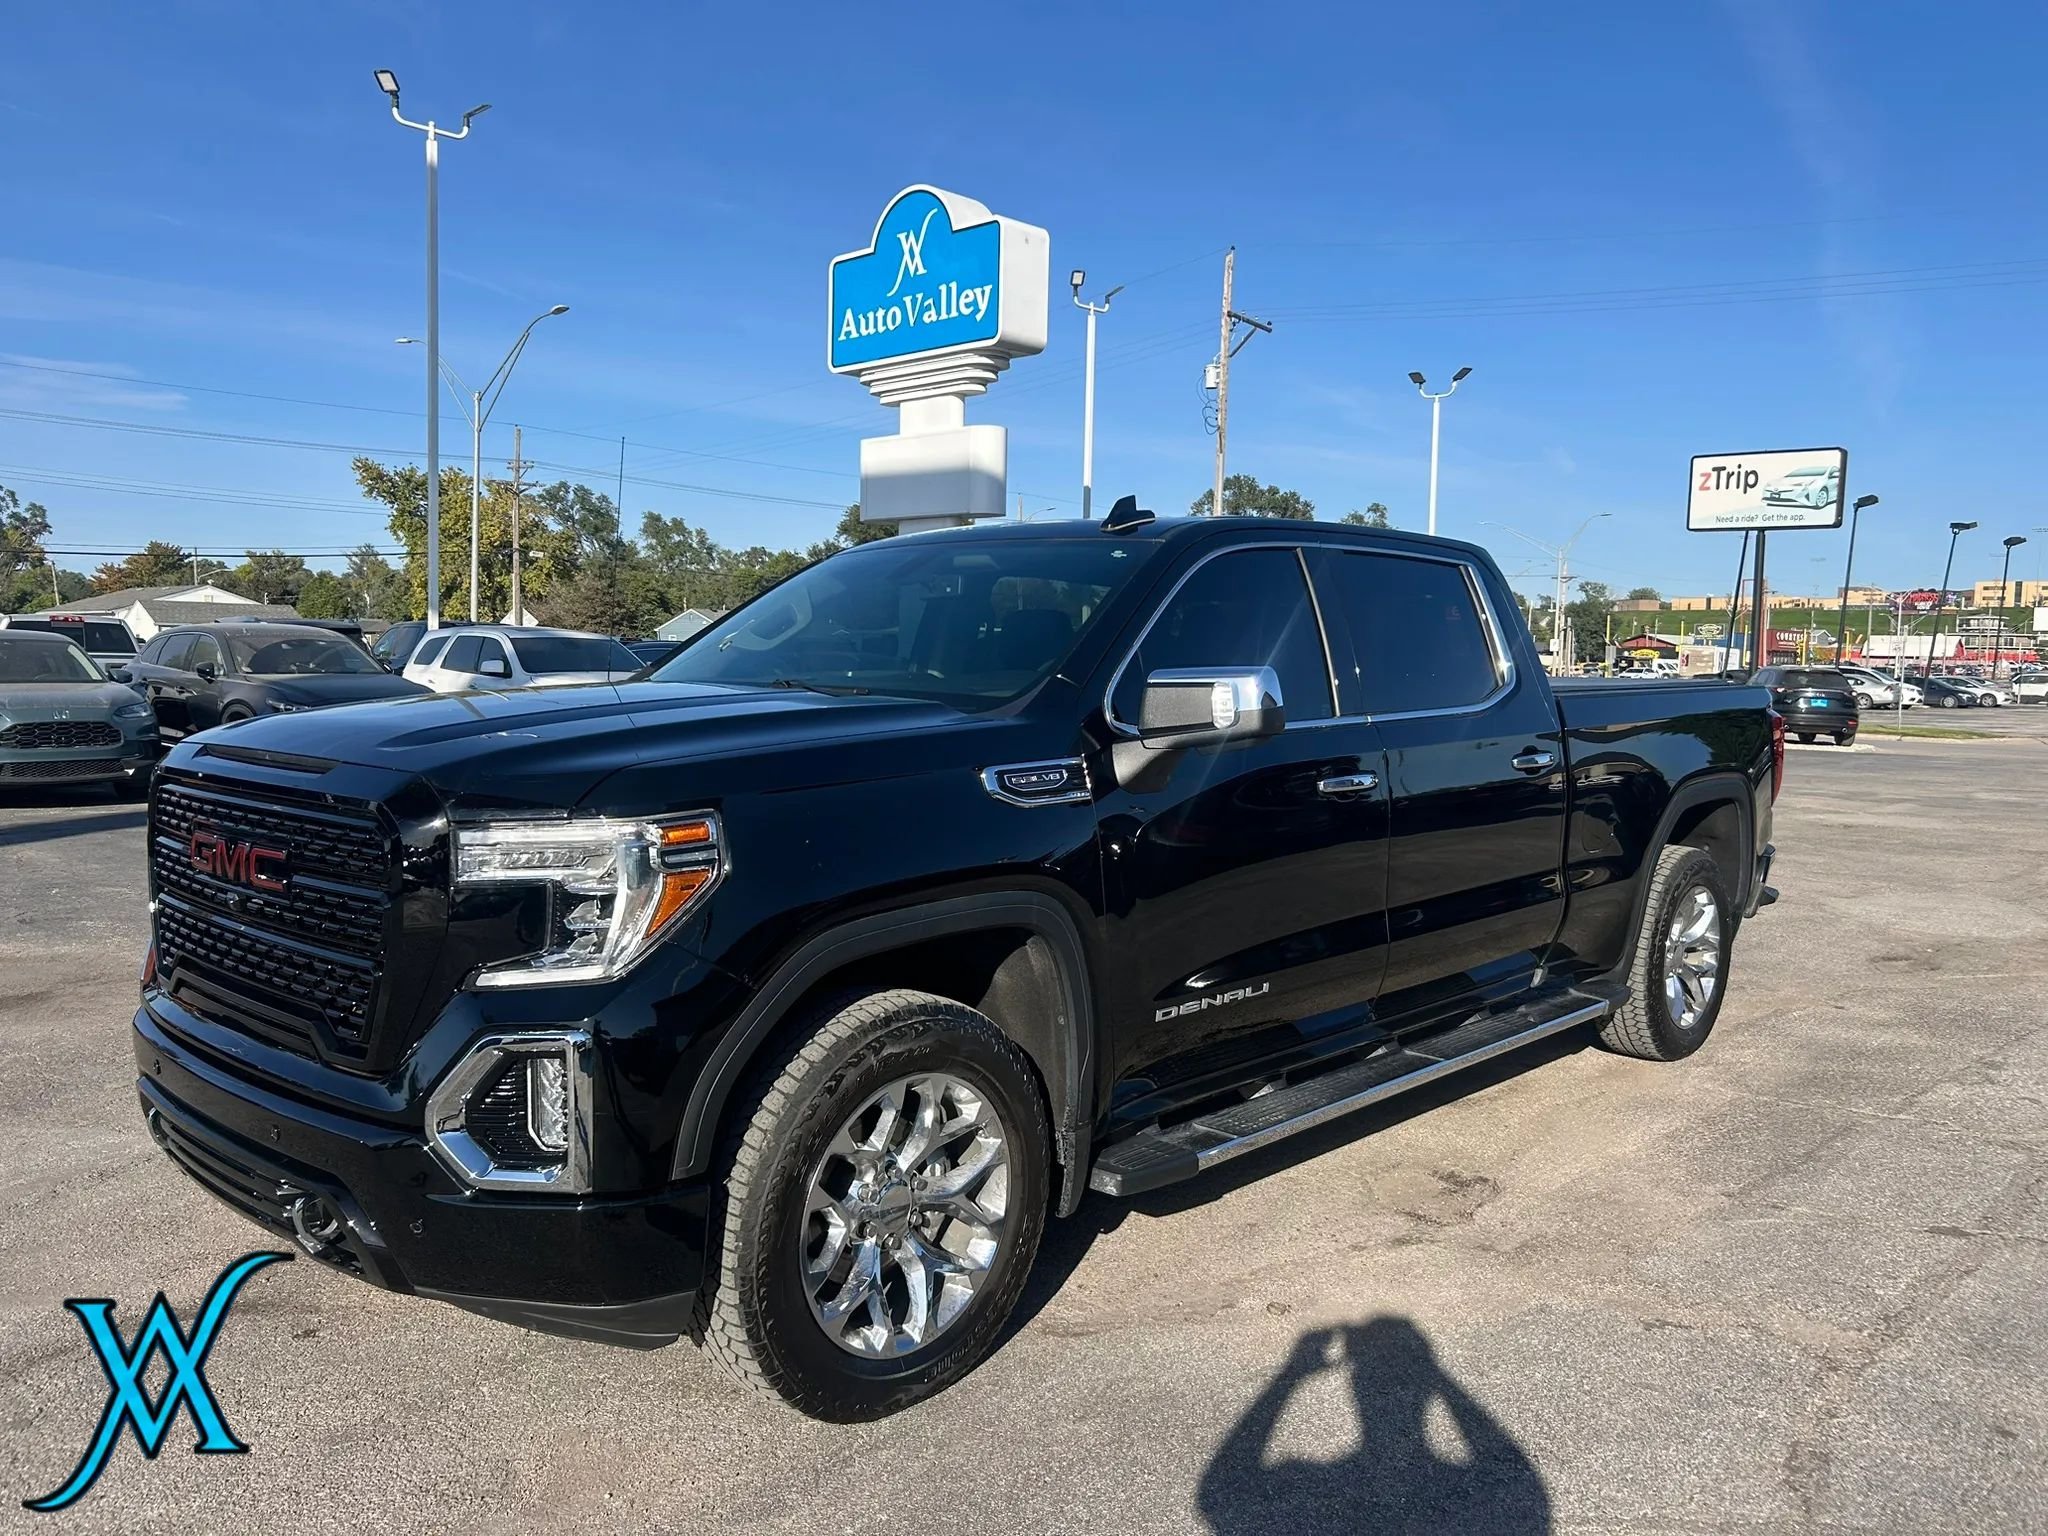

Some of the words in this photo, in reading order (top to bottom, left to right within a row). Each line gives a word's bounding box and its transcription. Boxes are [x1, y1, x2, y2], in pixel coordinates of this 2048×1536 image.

[1698, 463, 1759, 494] zTrip
[1715, 515, 1733, 523] Need
[1741, 514, 1758, 522] ride?
[1762, 513, 1775, 522] Get
[1776, 513, 1788, 521] the
[1790, 514, 1806, 523] app.
[191, 831, 286, 893] GMC
[1155, 982, 1269, 1022] DENALI
